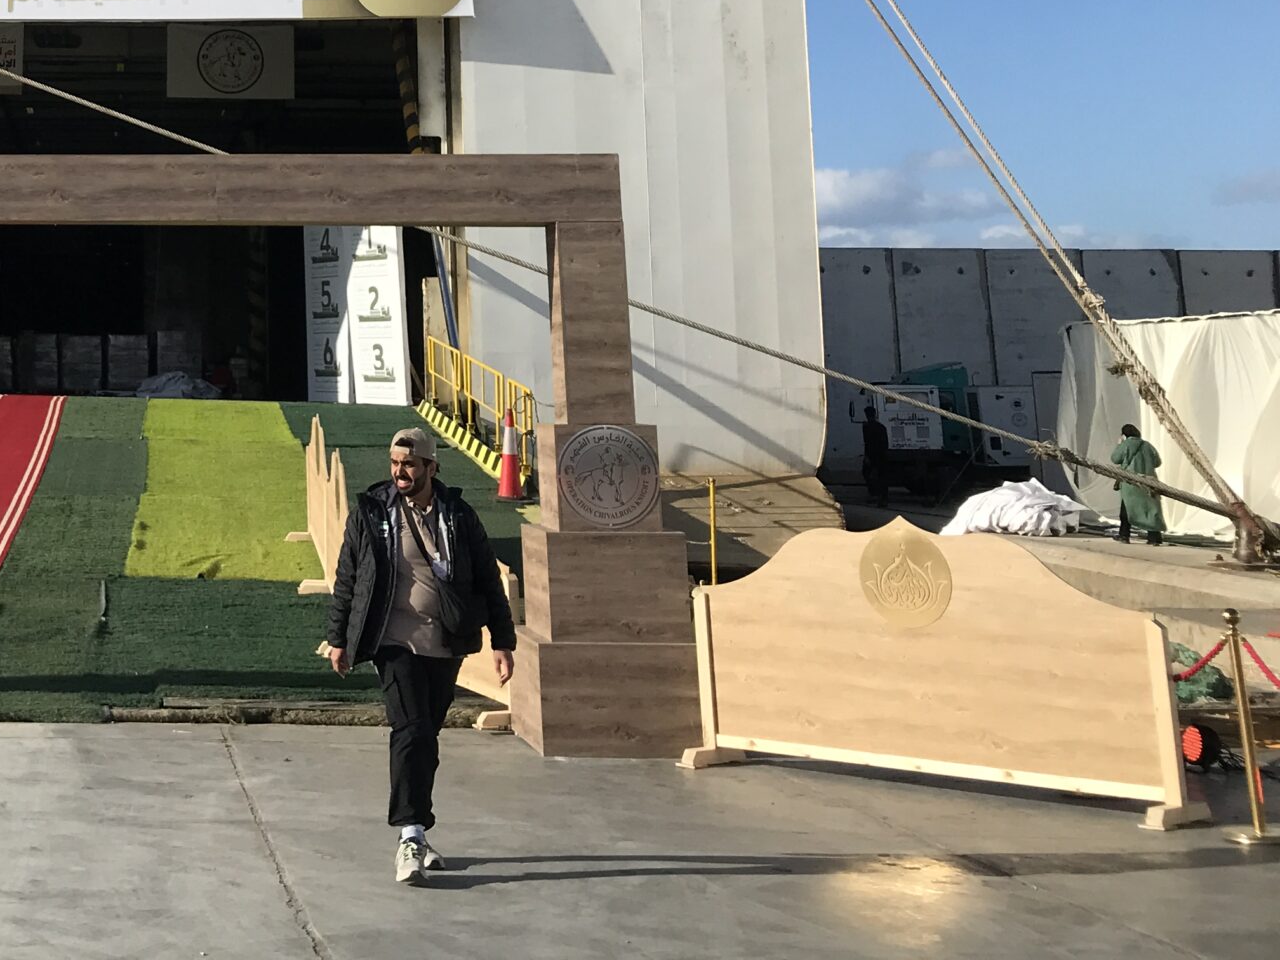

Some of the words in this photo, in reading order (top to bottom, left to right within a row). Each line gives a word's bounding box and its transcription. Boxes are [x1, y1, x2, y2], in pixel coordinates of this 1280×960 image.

[320, 227, 331, 252] 4
[320, 280, 332, 308] 5
[368, 286, 380, 311] 2
[323, 337, 334, 365] 6
[372, 344, 385, 371] 3
[593, 504, 637, 520] CHIVALROUS
